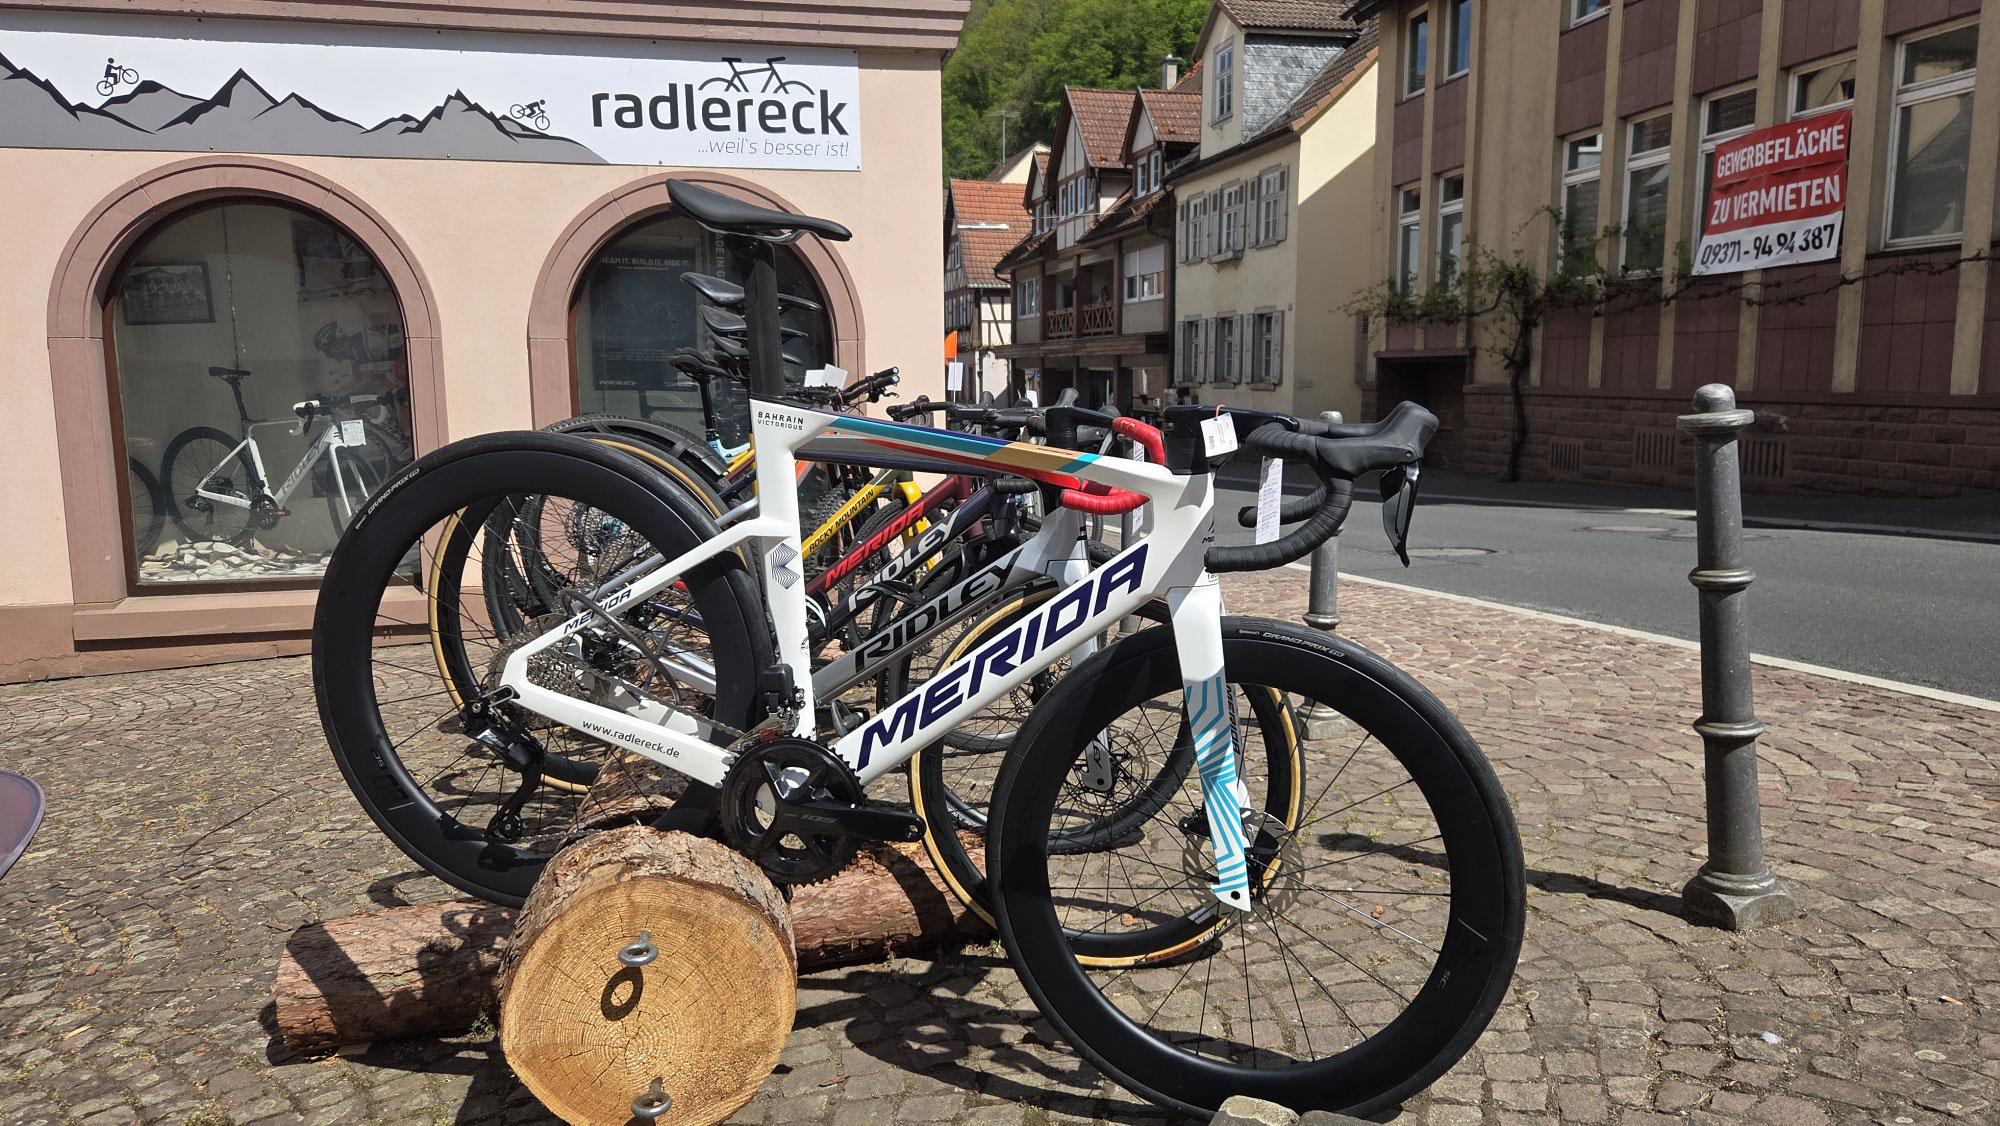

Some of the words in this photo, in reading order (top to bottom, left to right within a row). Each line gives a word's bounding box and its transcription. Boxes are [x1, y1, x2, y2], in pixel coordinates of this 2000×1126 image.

[592, 83, 849, 136] radlereck
[764, 138, 820, 157] besser
[826, 140, 849, 157] ist!
[1717, 124, 1845, 178] GEWERBEFLÄCHE
[1711, 199, 1730, 225] ZU
[1733, 174, 1840, 221] VERMIETEN
[602, 256, 621, 264] EAM
[715, 232, 725, 254] ADE
[757, 411, 804, 425] BAHRAIN
[757, 419, 803, 431] VICTORIOUS
[809, 523, 835, 553] ROCKY
[835, 488, 874, 530] MOUNTAIN
[824, 501, 925, 588] MERIDA
[855, 547, 1024, 674] RIDLEY
[856, 543, 1149, 773] MERIDA
[1262, 631, 1303, 645] GRAND
[1301, 640, 1331, 653] PRIX
[582, 720, 680, 759] www.radlereck.de
[1226, 685, 1241, 756] MERIDA
